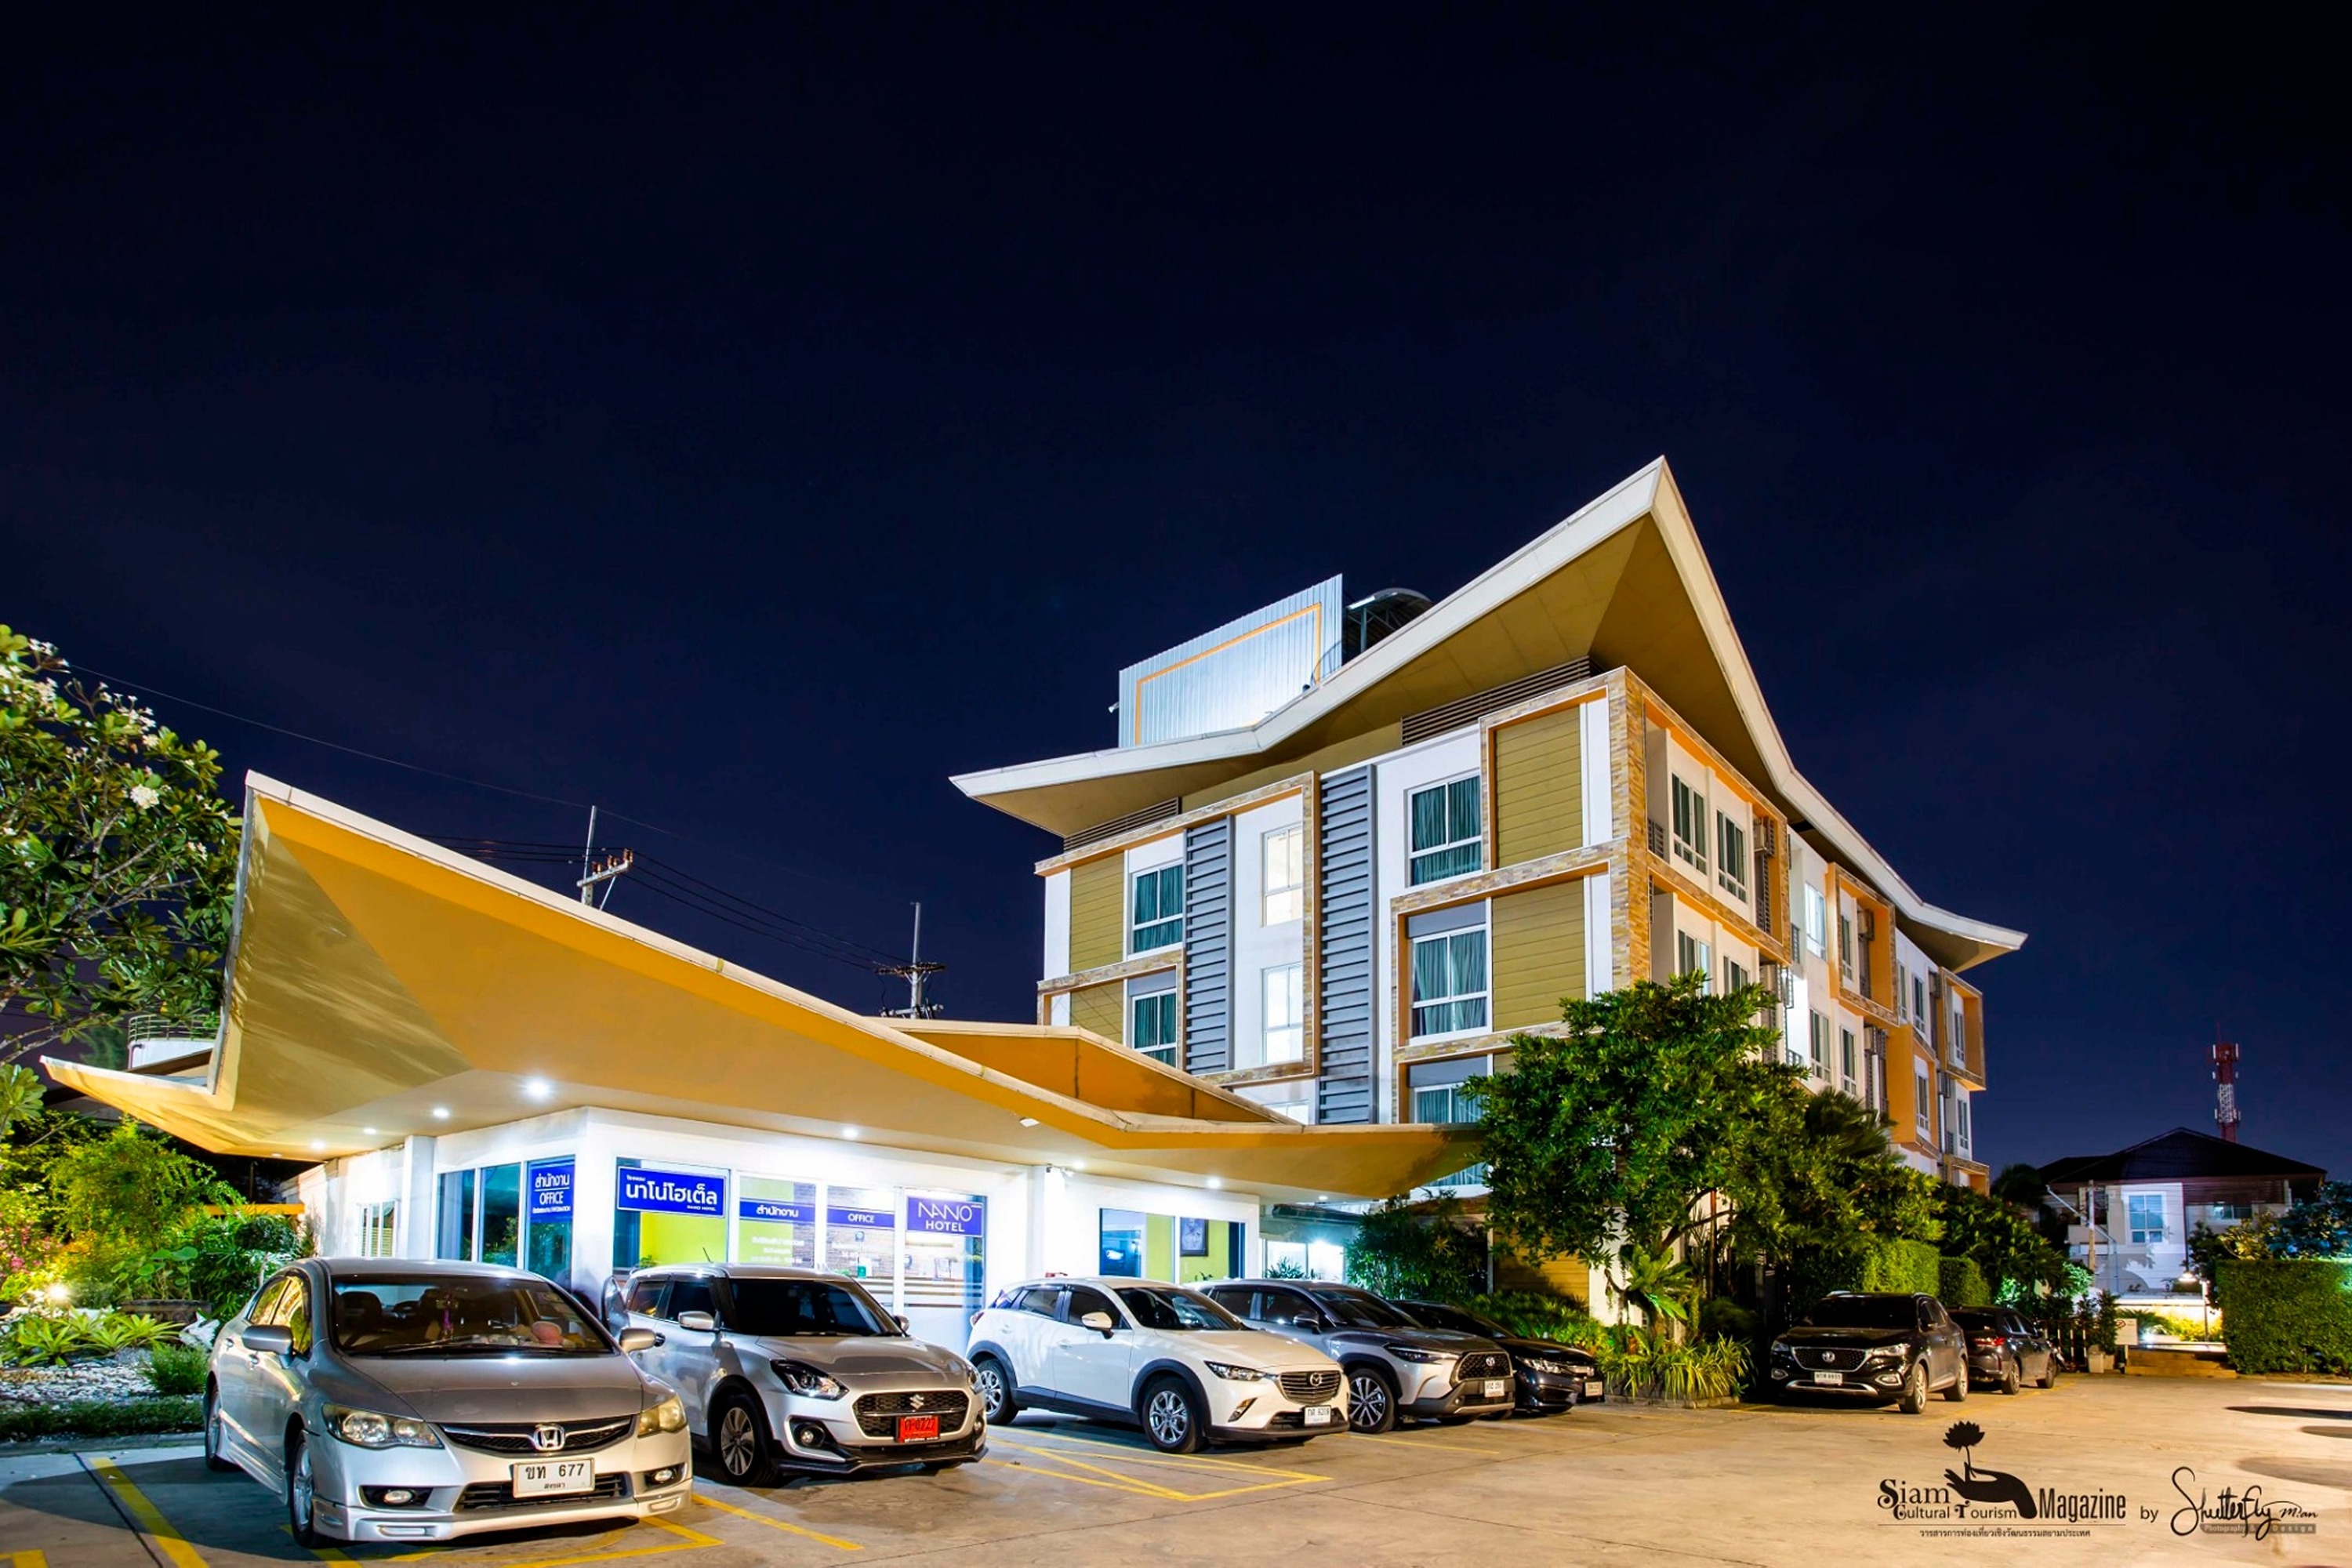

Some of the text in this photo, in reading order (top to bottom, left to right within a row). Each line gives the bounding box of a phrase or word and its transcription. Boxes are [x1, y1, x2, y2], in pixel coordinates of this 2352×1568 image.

[535, 1173, 570, 1188] สำนักงาน
[539, 1191, 564, 1205] OFFICE
[756, 1204, 799, 1218] สำนักงาน
[918, 1201, 972, 1222] NANO
[848, 1214, 875, 1224] OFFICE
[925, 1220, 965, 1232] HOTEL
[558, 1463, 584, 1477] 677
